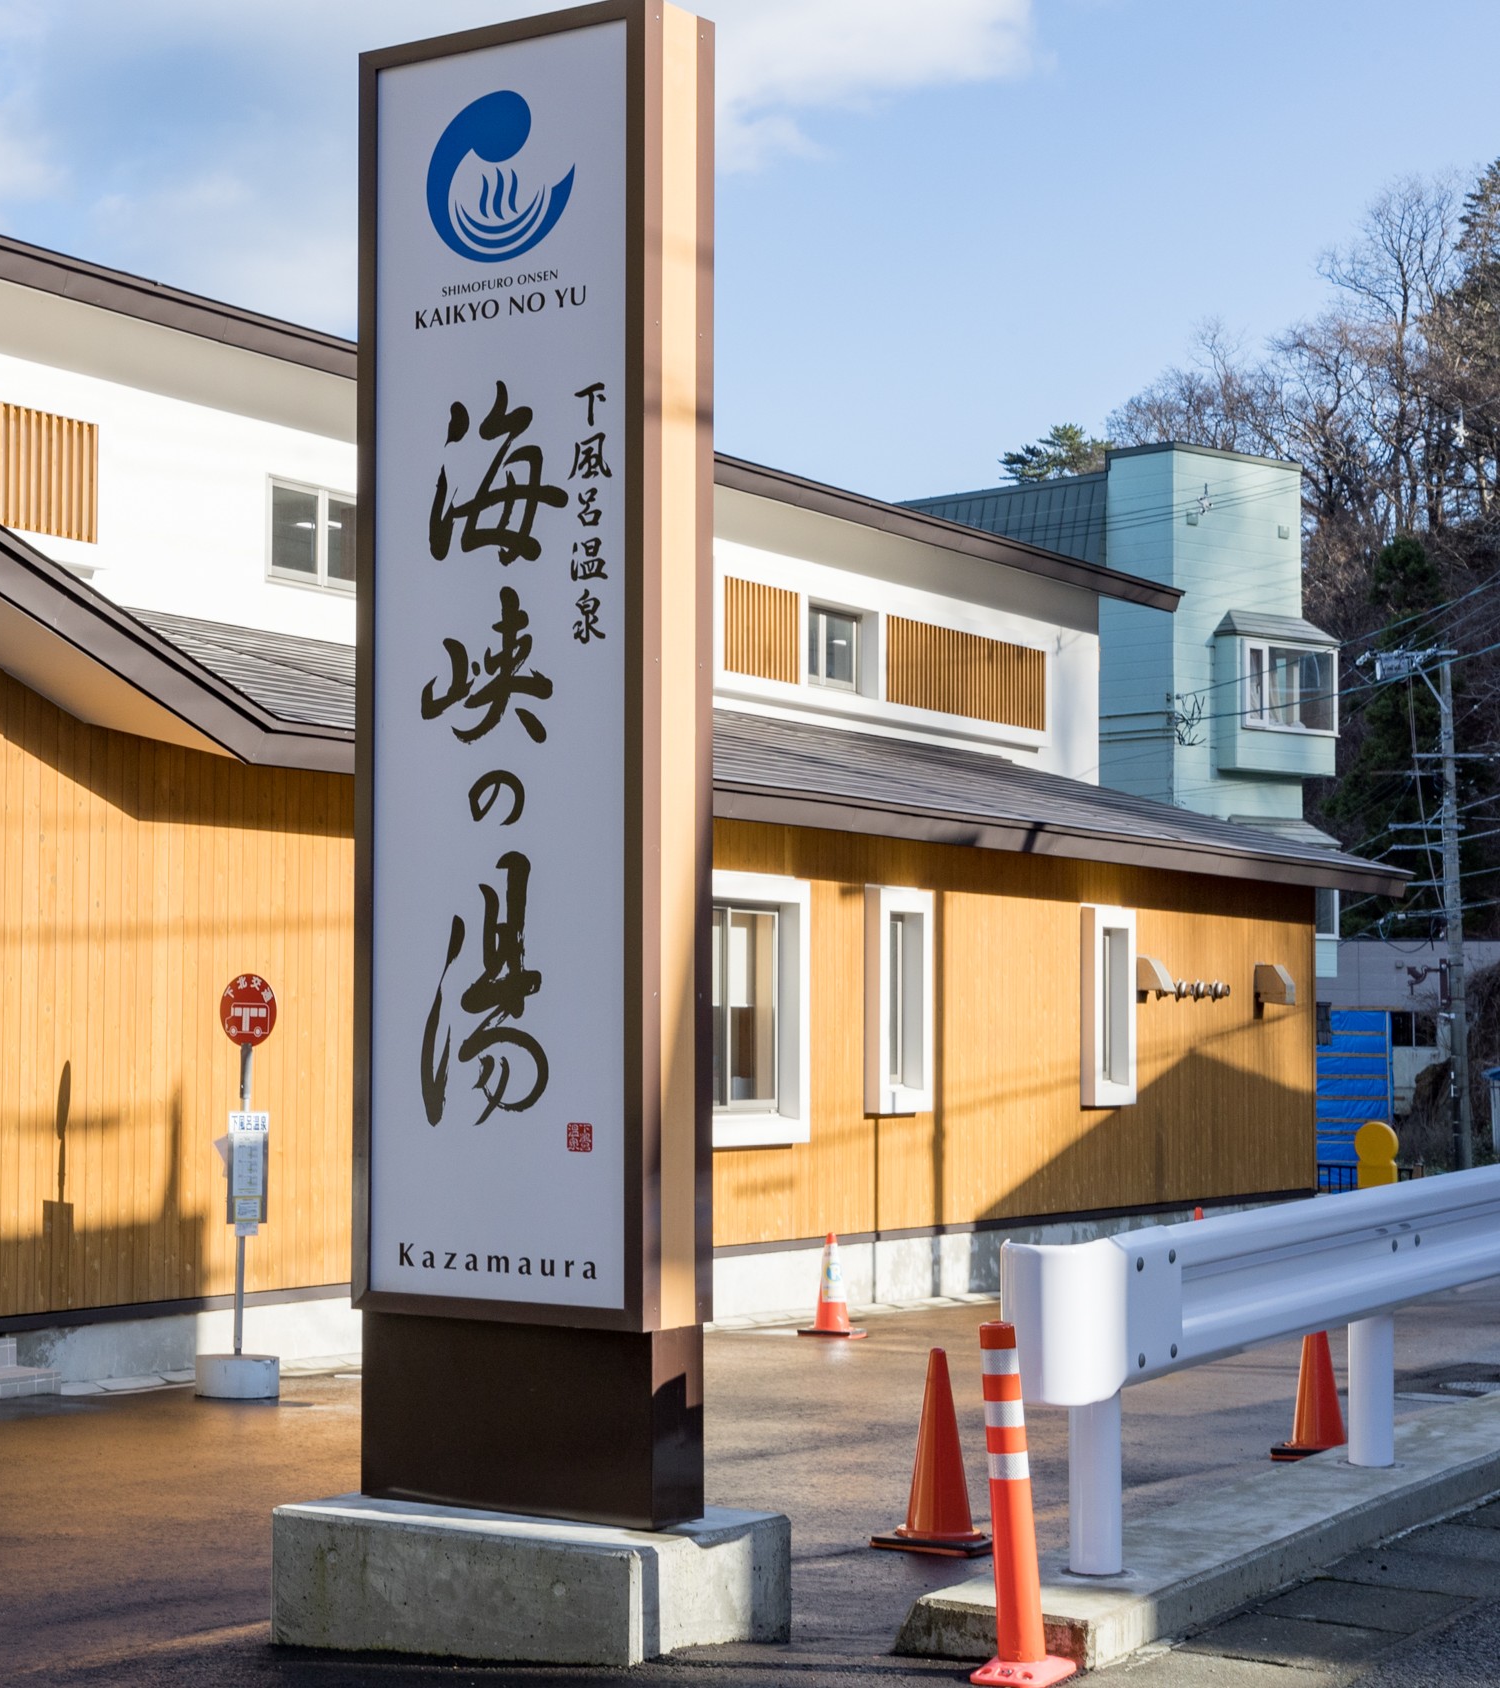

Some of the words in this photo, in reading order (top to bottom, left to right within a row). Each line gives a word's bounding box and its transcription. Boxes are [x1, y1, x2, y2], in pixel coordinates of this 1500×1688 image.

[441, 276, 513, 298] SHIMOFURO
[517, 269, 559, 286] ONSEN
[414, 299, 500, 330] KAIKYO
[509, 291, 546, 316] NO
[554, 285, 588, 309] YU
[568, 382, 613, 644] 下風呂温泉
[420, 380, 569, 1127] 海峡の湯
[224, 976, 273, 1003] 下北交通
[398, 1242, 598, 1280] Kazamaura
